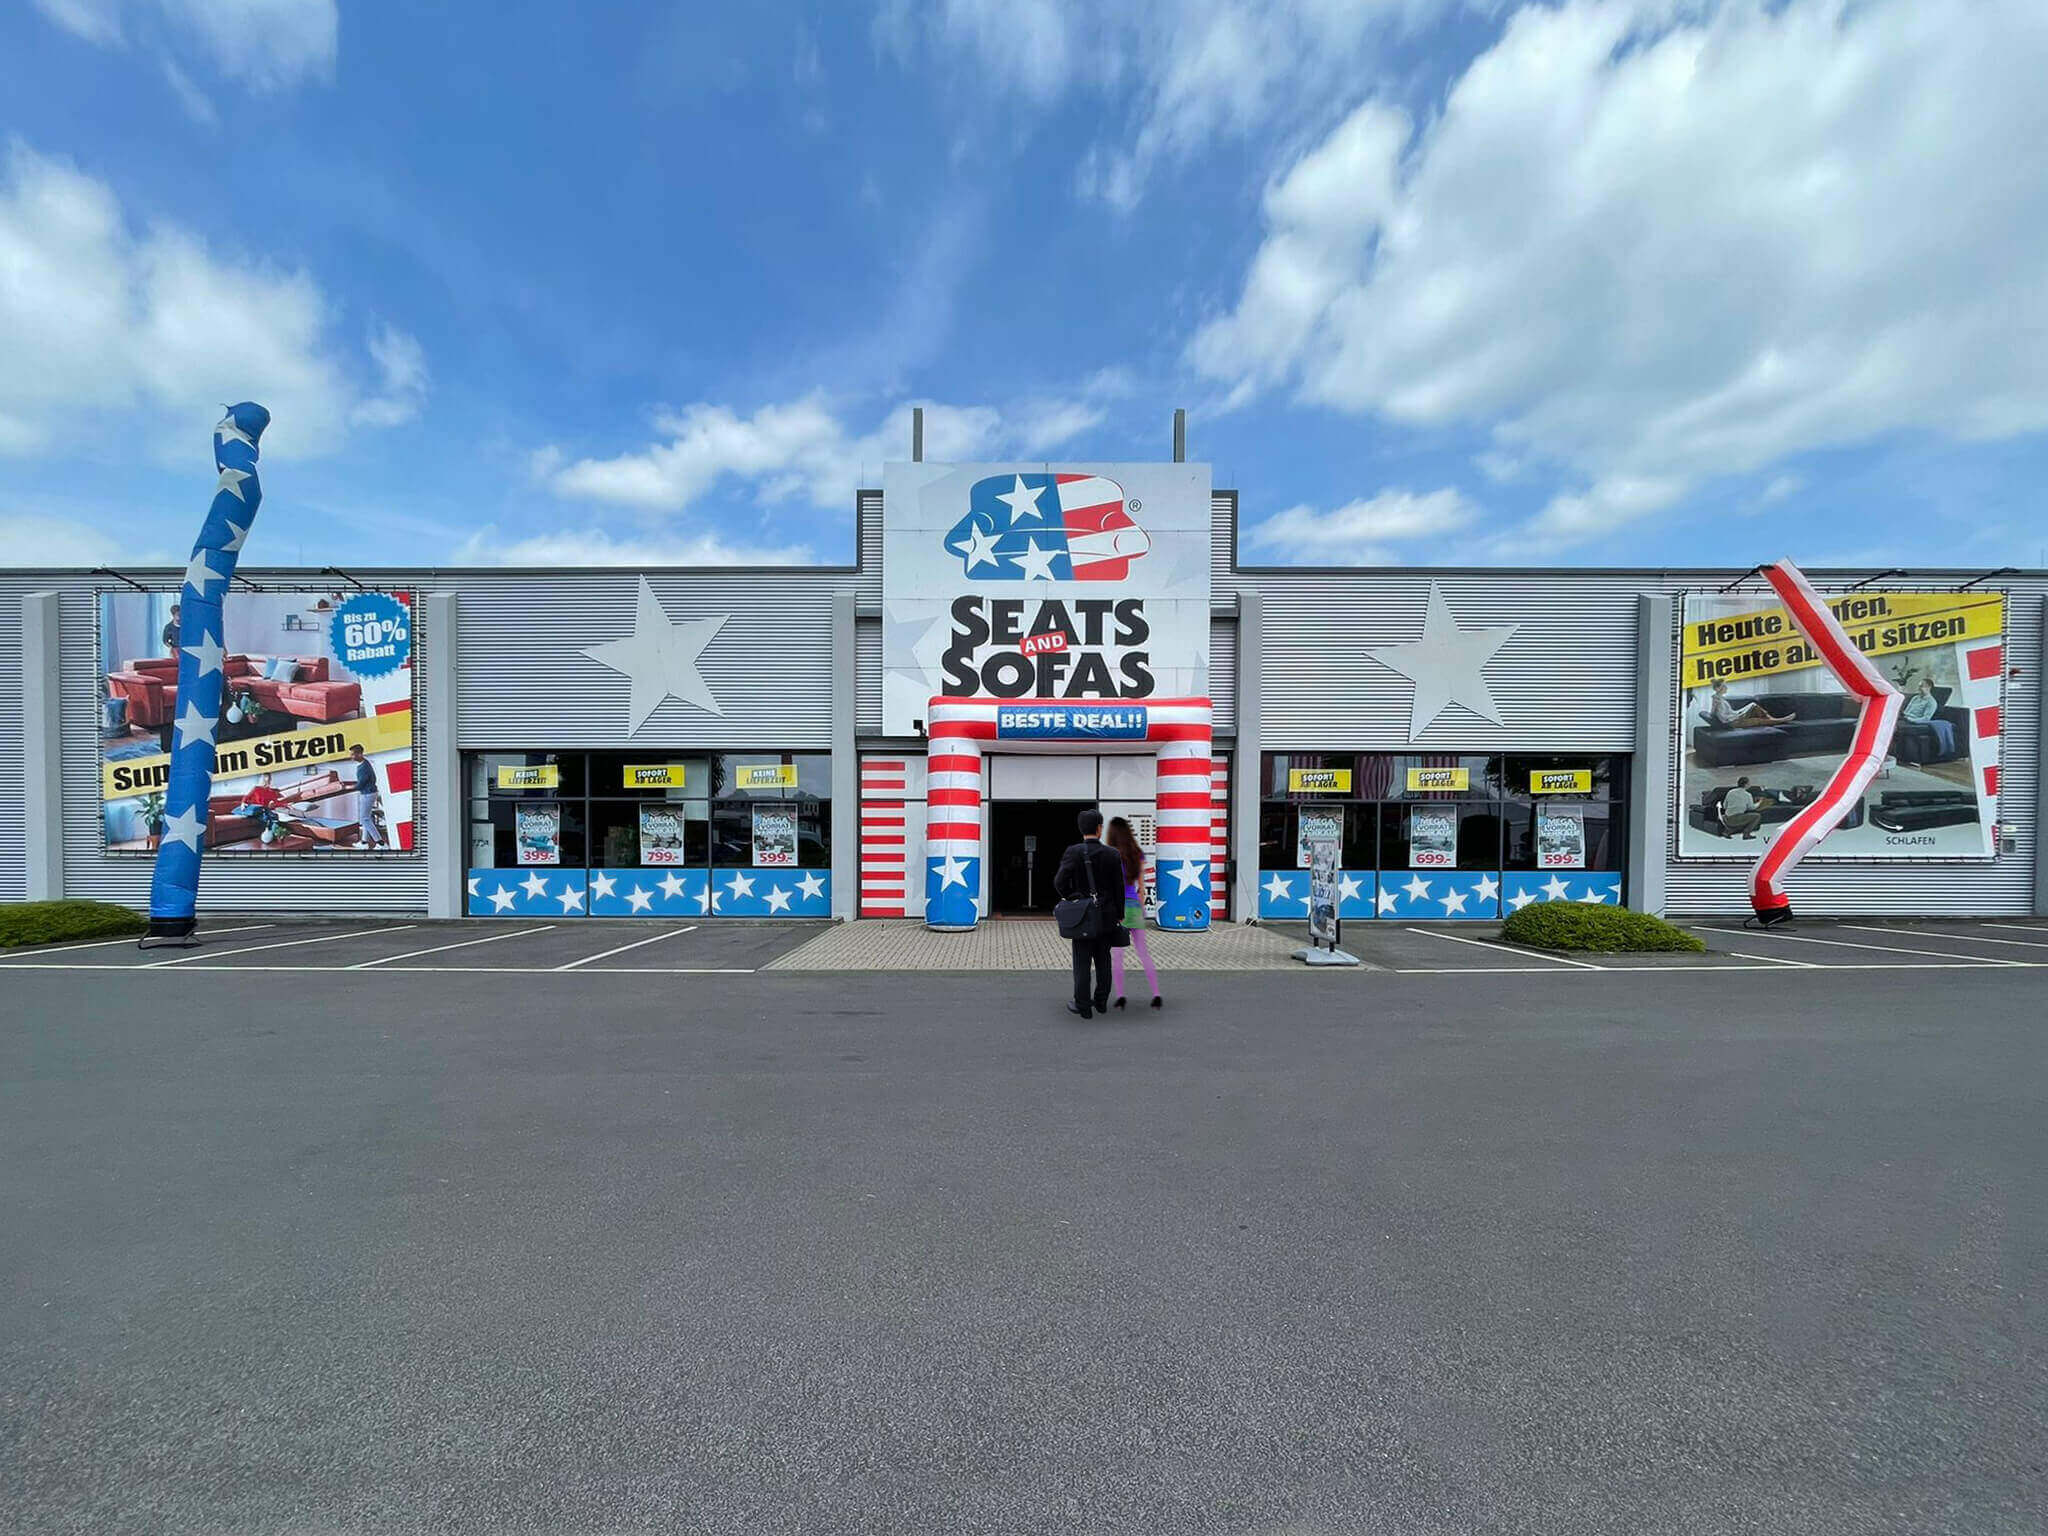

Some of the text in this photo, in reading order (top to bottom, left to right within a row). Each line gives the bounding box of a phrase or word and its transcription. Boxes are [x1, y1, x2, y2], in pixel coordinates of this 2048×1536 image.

[344, 612, 377, 624] Bis zu
[951, 595, 1150, 648] SEATS
[345, 615, 407, 647] 60%
[1698, 614, 1782, 646] Heute
[1024, 633, 1065, 653] AND
[1697, 650, 1780, 680] heute
[1882, 616, 1966, 647] sitzen
[347, 644, 396, 661] Rabatt
[942, 649, 1155, 698] SOFAS
[1001, 713, 1142, 729] BESTE DEAL!!
[254, 731, 345, 767] Sitzen
[637, 769, 667, 778] SOFORT
[1302, 773, 1334, 782] SOFORT
[1420, 772, 1450, 781] SOFORT
[1543, 775, 1574, 783] SOFORT
[1886, 836, 1936, 845] SCHLAFEN
